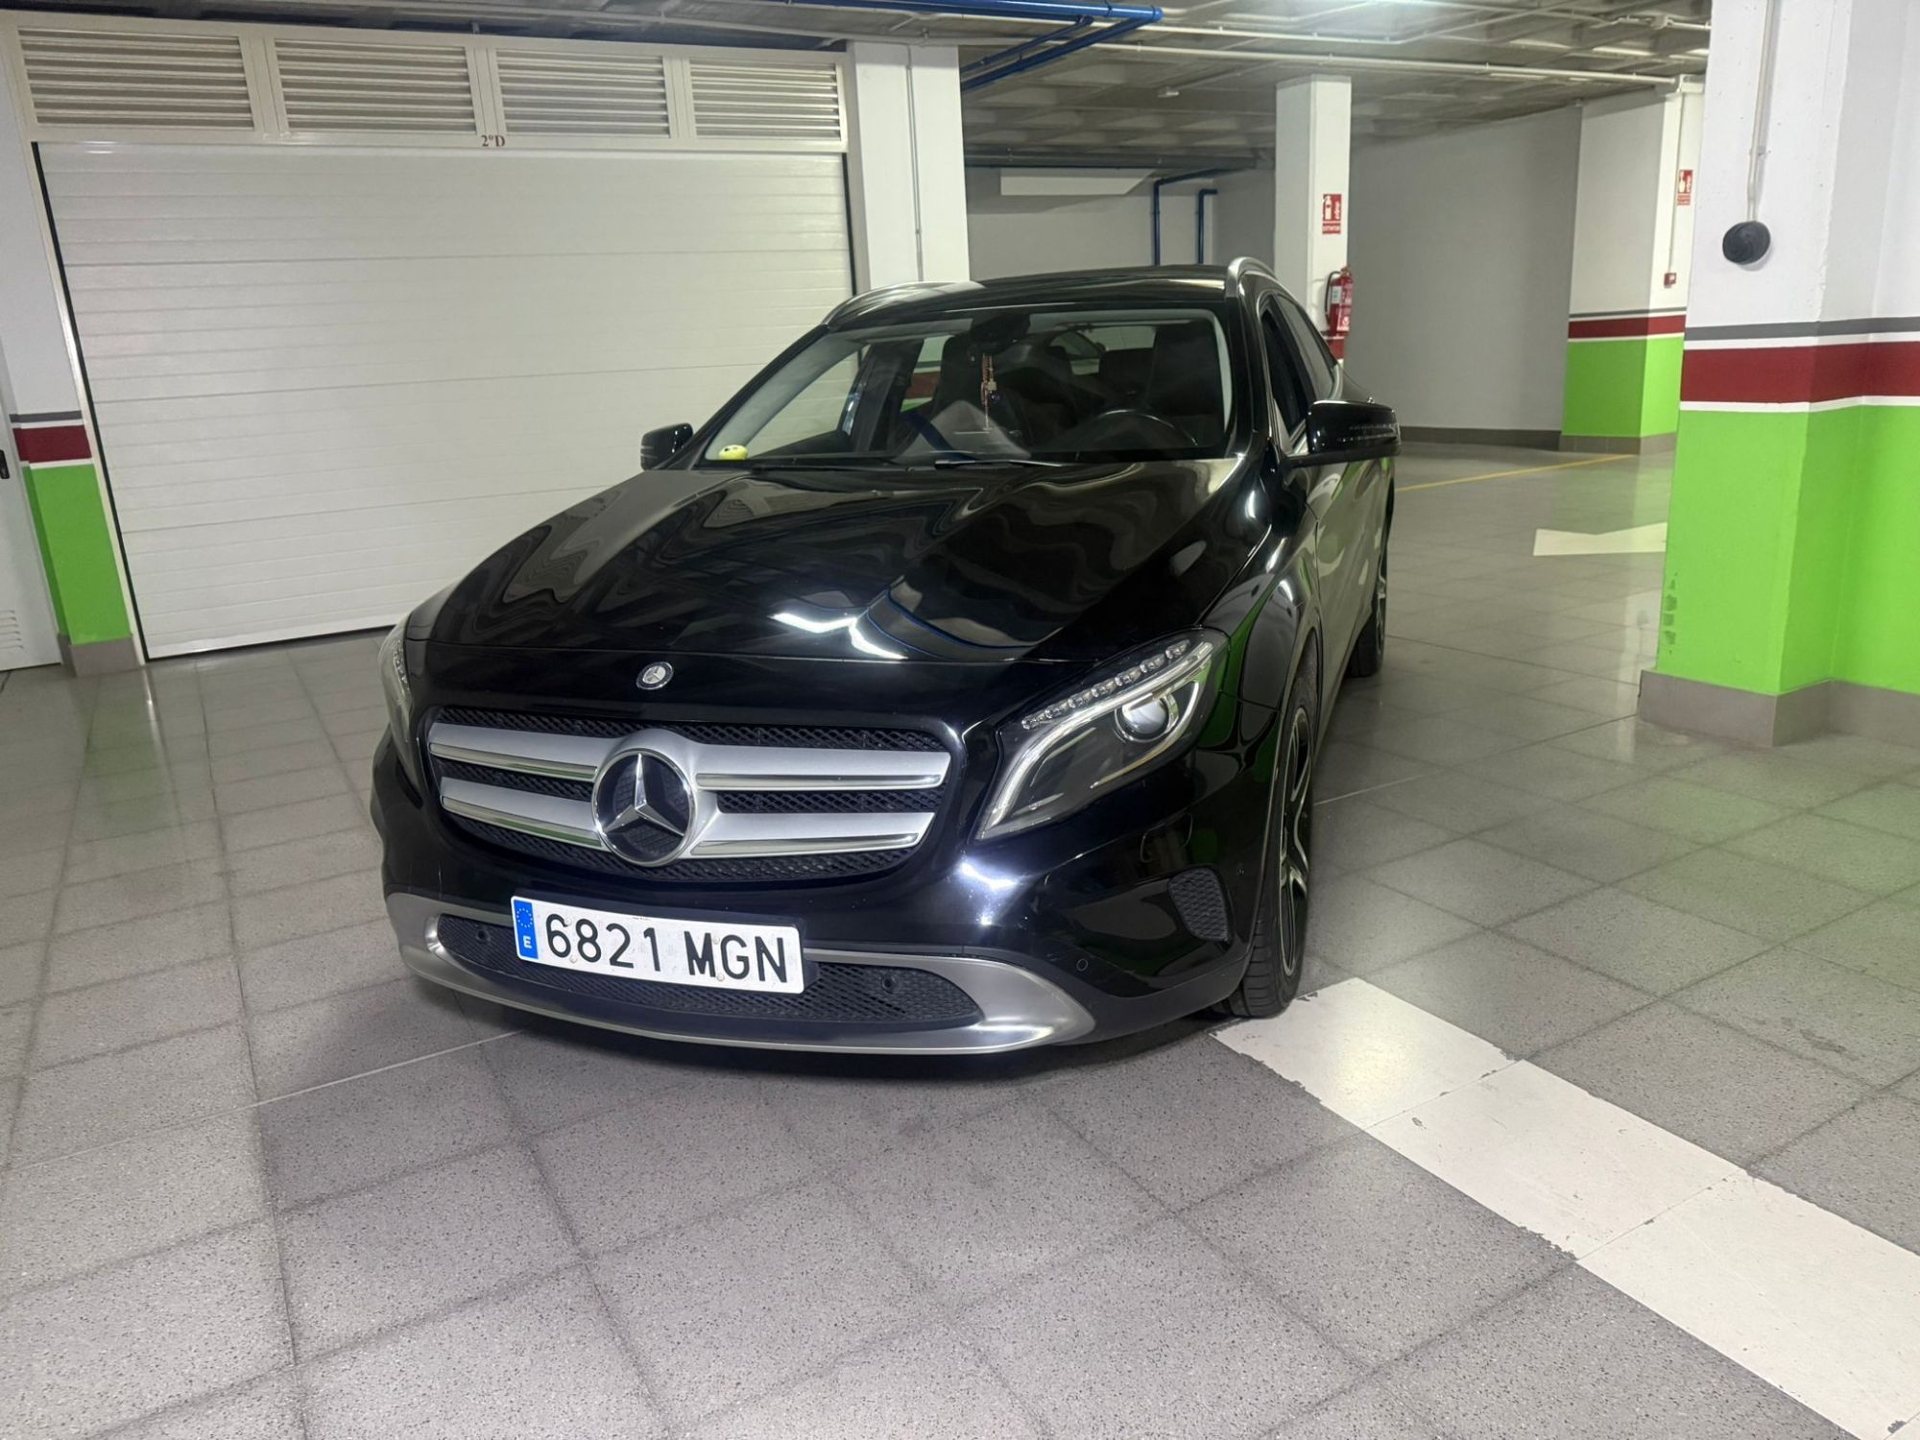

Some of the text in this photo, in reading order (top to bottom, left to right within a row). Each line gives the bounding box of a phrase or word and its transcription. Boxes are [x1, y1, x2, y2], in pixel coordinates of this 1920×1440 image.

[523, 935, 532, 949] E
[545, 913, 788, 983] 6821 MGN
